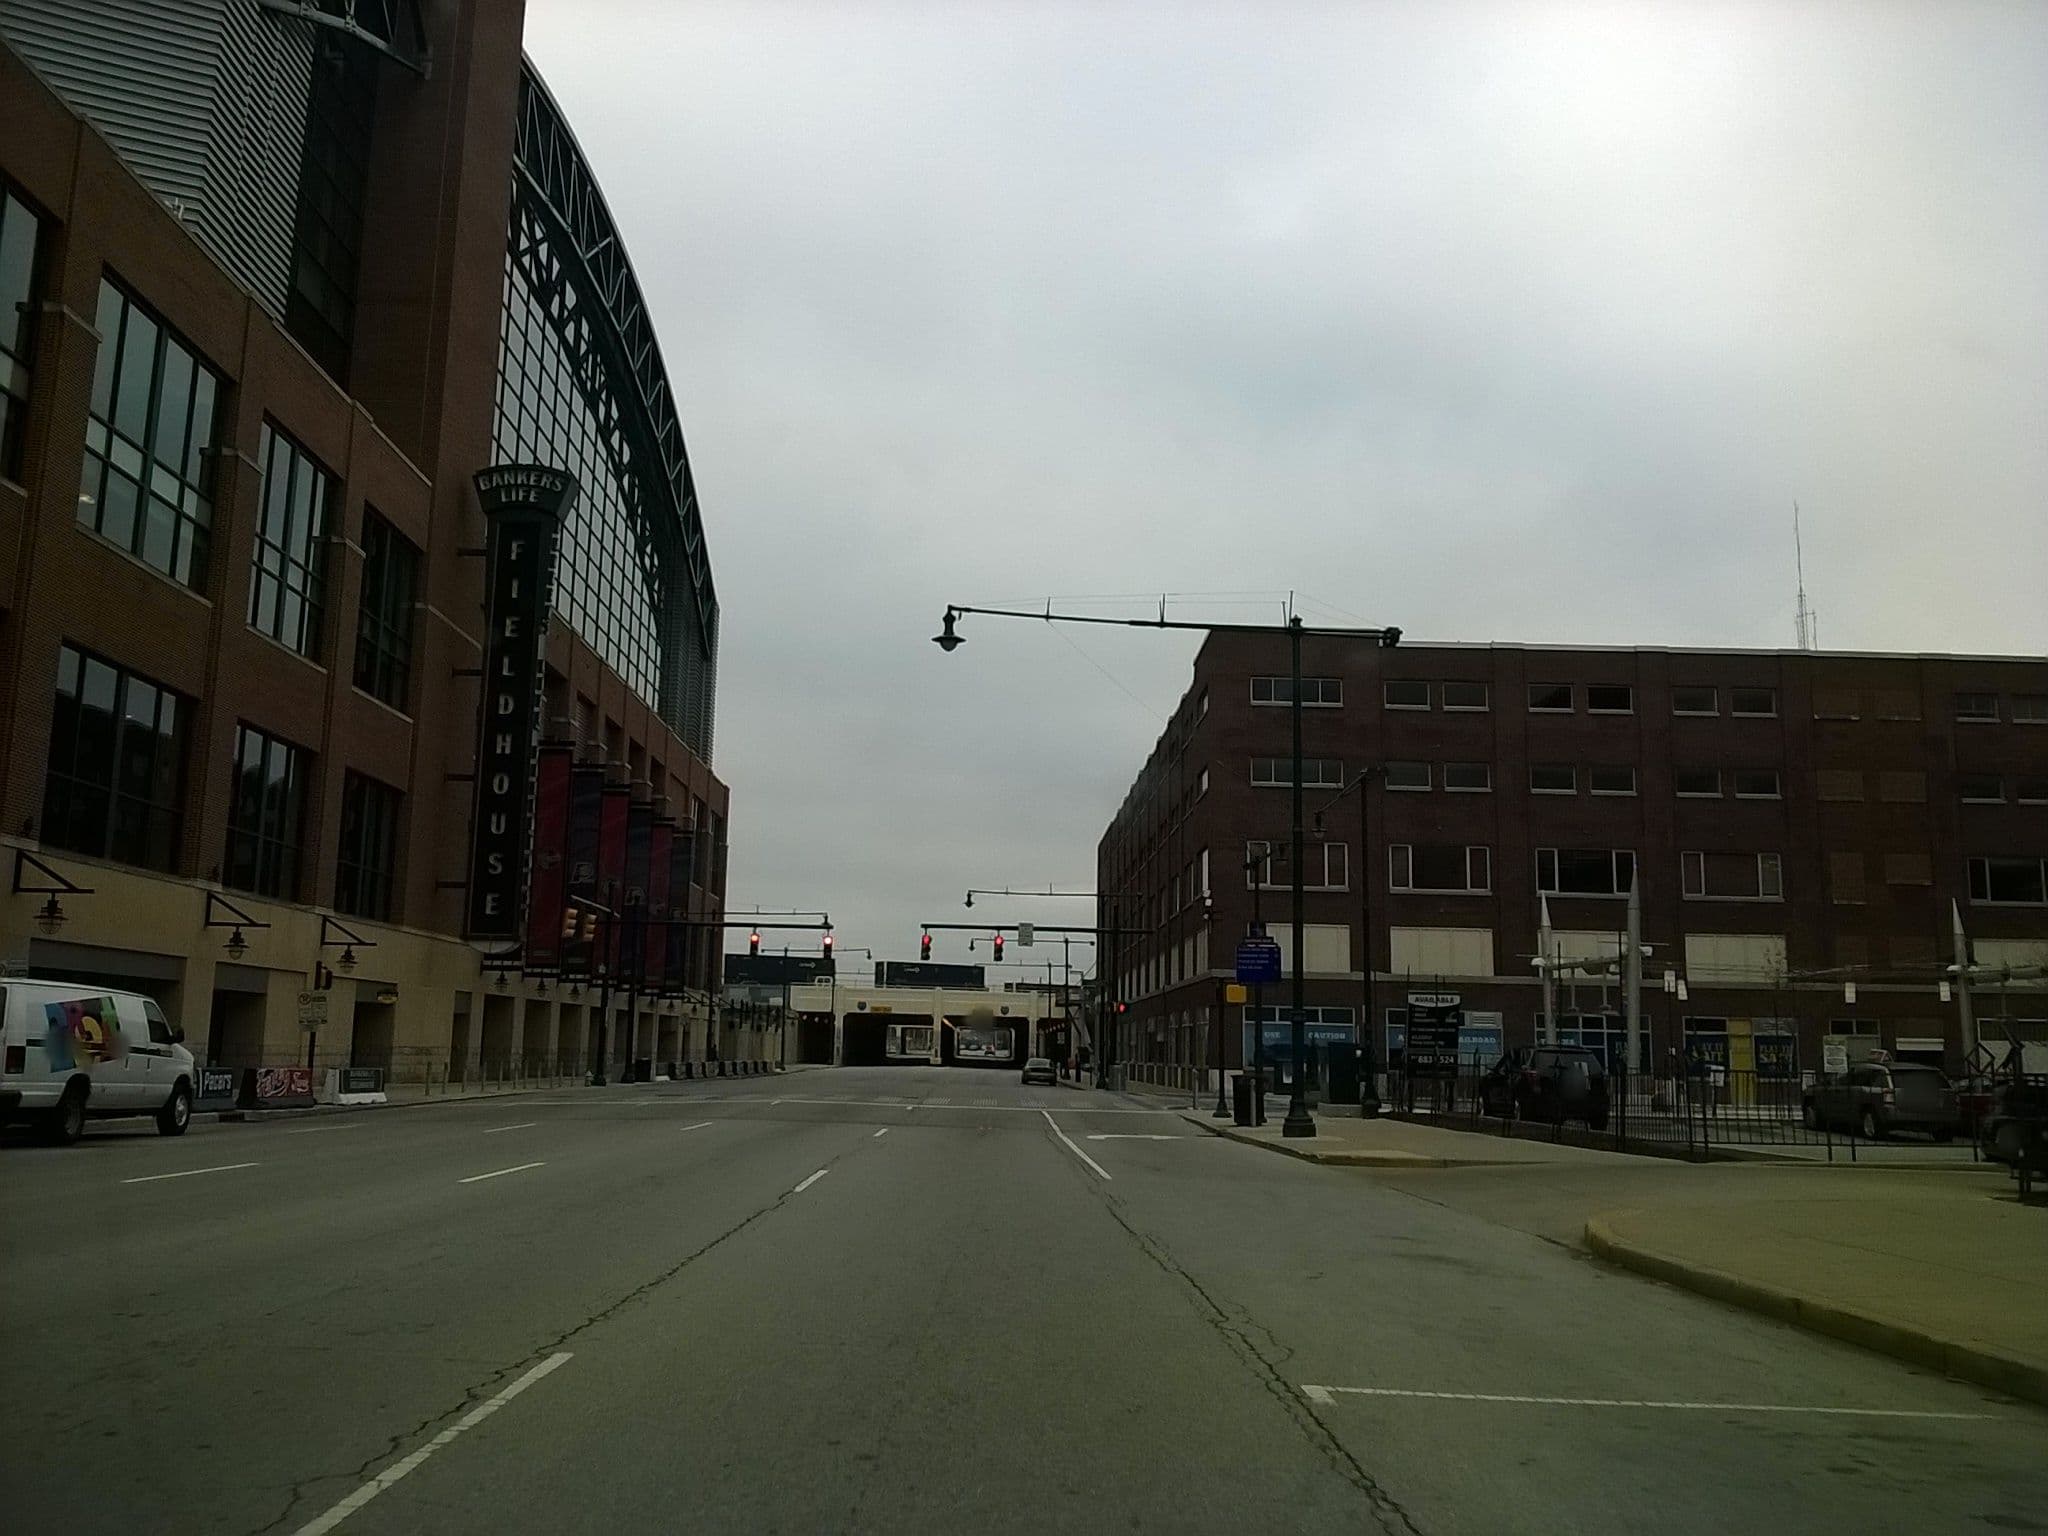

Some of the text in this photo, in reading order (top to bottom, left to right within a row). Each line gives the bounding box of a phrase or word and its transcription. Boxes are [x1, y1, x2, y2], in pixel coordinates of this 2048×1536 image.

[478, 469, 562, 492] BANKERS
[501, 488, 538, 503] LIFE
[483, 540, 526, 917] FIELDHOUSE
[1308, 1032, 1346, 1040] CAUTION
[204, 1072, 232, 1091] Pacers
